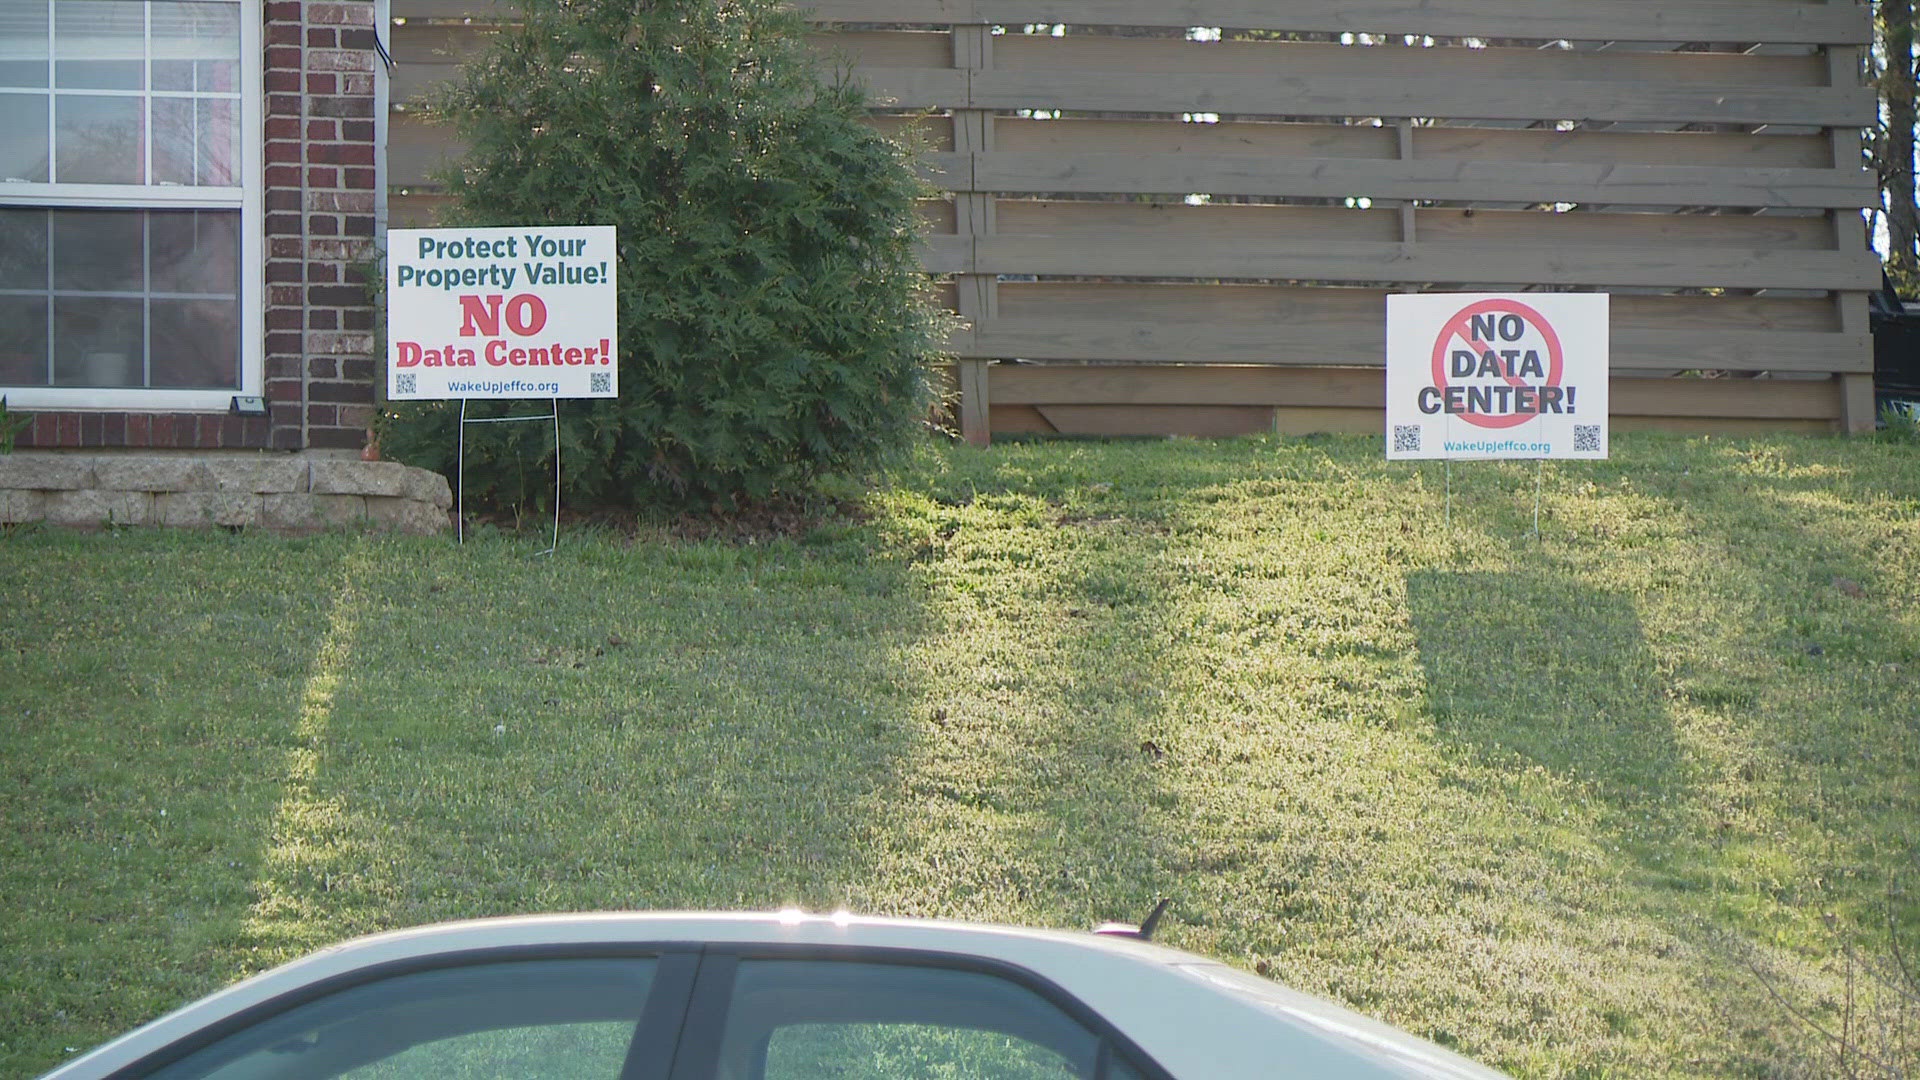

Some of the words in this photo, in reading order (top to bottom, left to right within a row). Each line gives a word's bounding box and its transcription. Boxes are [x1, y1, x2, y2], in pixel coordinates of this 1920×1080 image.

[418, 236, 518, 259] Protect
[524, 235, 587, 257] Your
[397, 264, 516, 291] Property
[524, 261, 608, 285] Value!
[459, 293, 547, 337] NO
[1471, 314, 1525, 342] NO
[396, 341, 476, 368] Data
[484, 338, 610, 367] Center!
[1451, 350, 1544, 378] DATA
[448, 380, 559, 394] WakeUpJeffco.org
[1417, 386, 1577, 415] CENTER!
[1443, 440, 1551, 454] WakeUpJeffco.org
